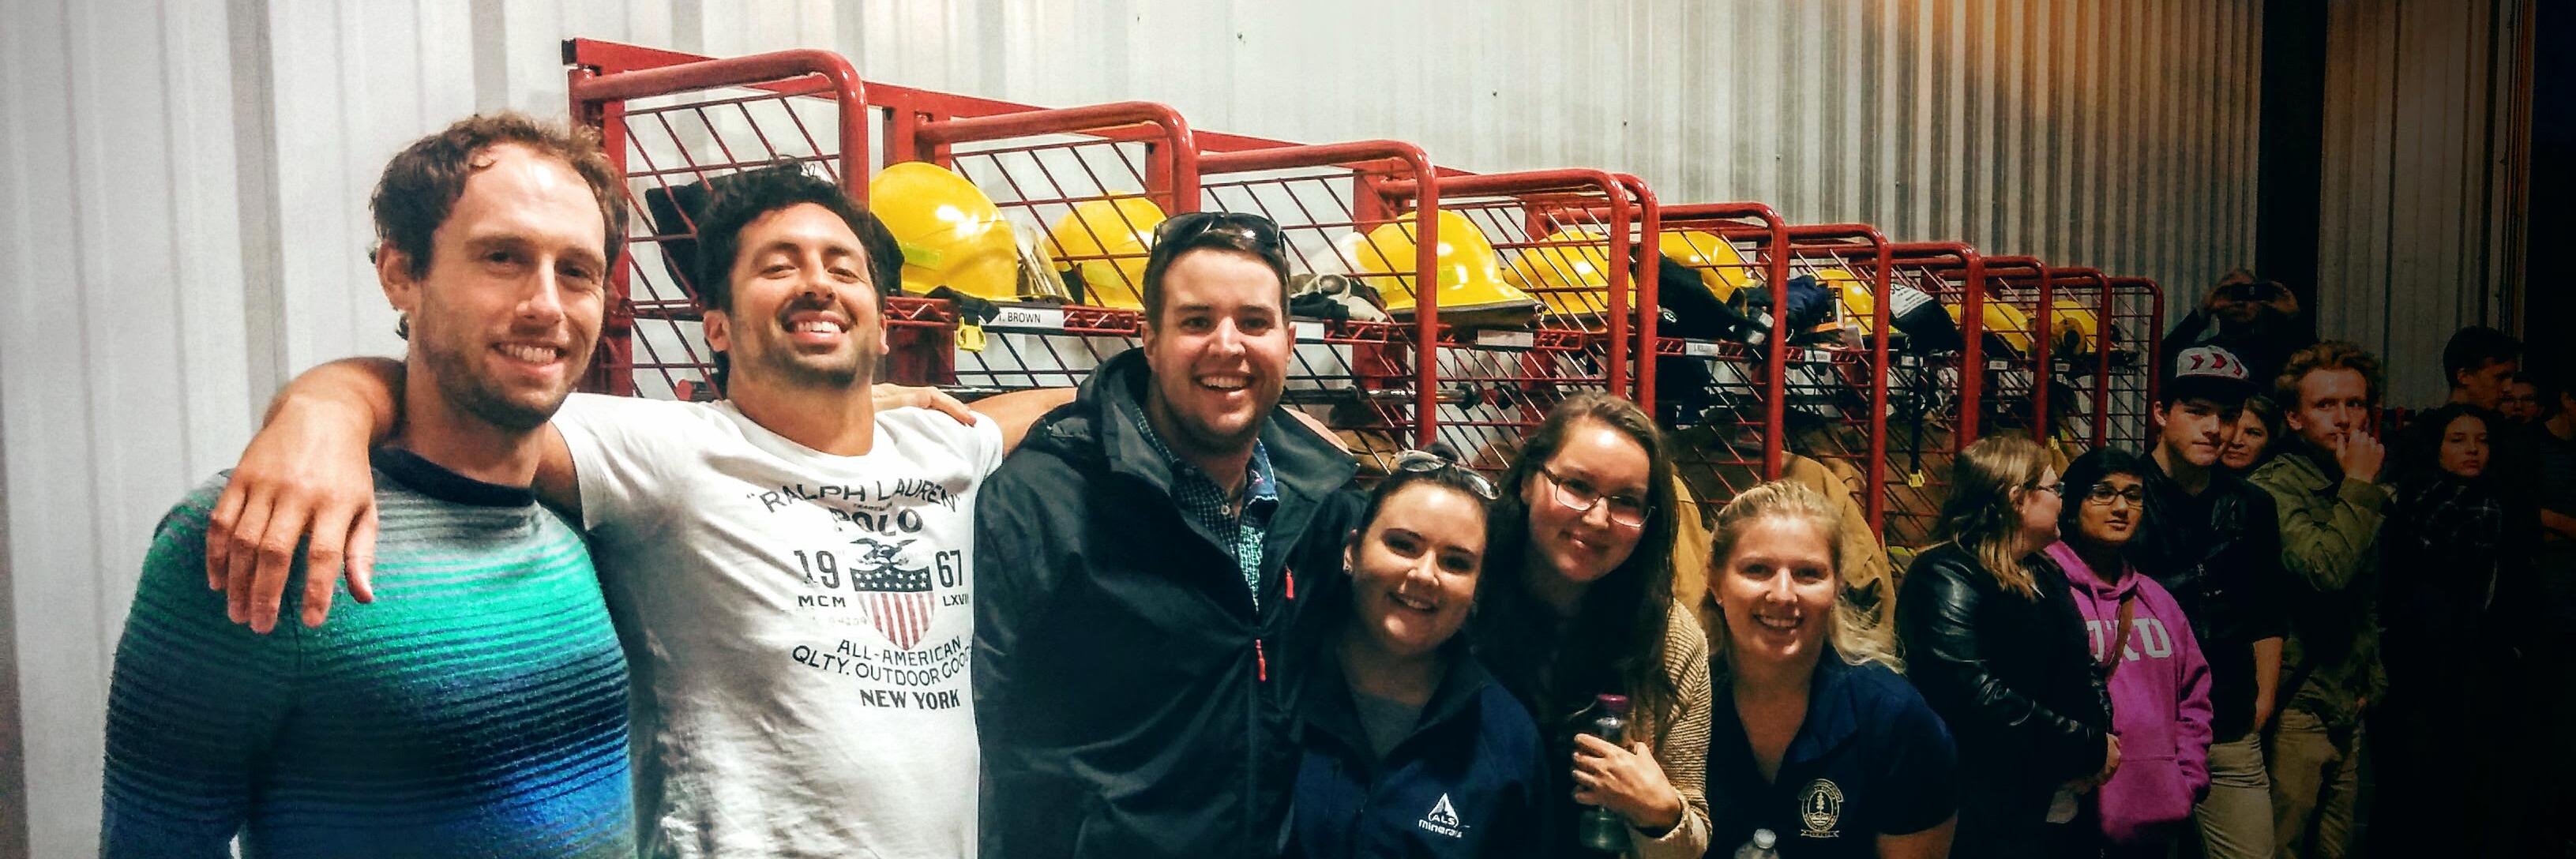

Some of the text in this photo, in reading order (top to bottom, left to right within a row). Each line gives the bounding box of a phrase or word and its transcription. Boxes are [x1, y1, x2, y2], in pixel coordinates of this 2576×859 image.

[1008, 311, 1041, 323] BROWN
[828, 508, 923, 536] POLO
[793, 549, 963, 588] 19 67
[798, 595, 846, 607] MCM
[837, 636, 961, 667] ALL-AMERICAN
[792, 644, 850, 676] QLTY.
[855, 662, 941, 687] OUTDOOR
[860, 688, 960, 710] NEW YORK
[1432, 814, 1455, 826] ALS
